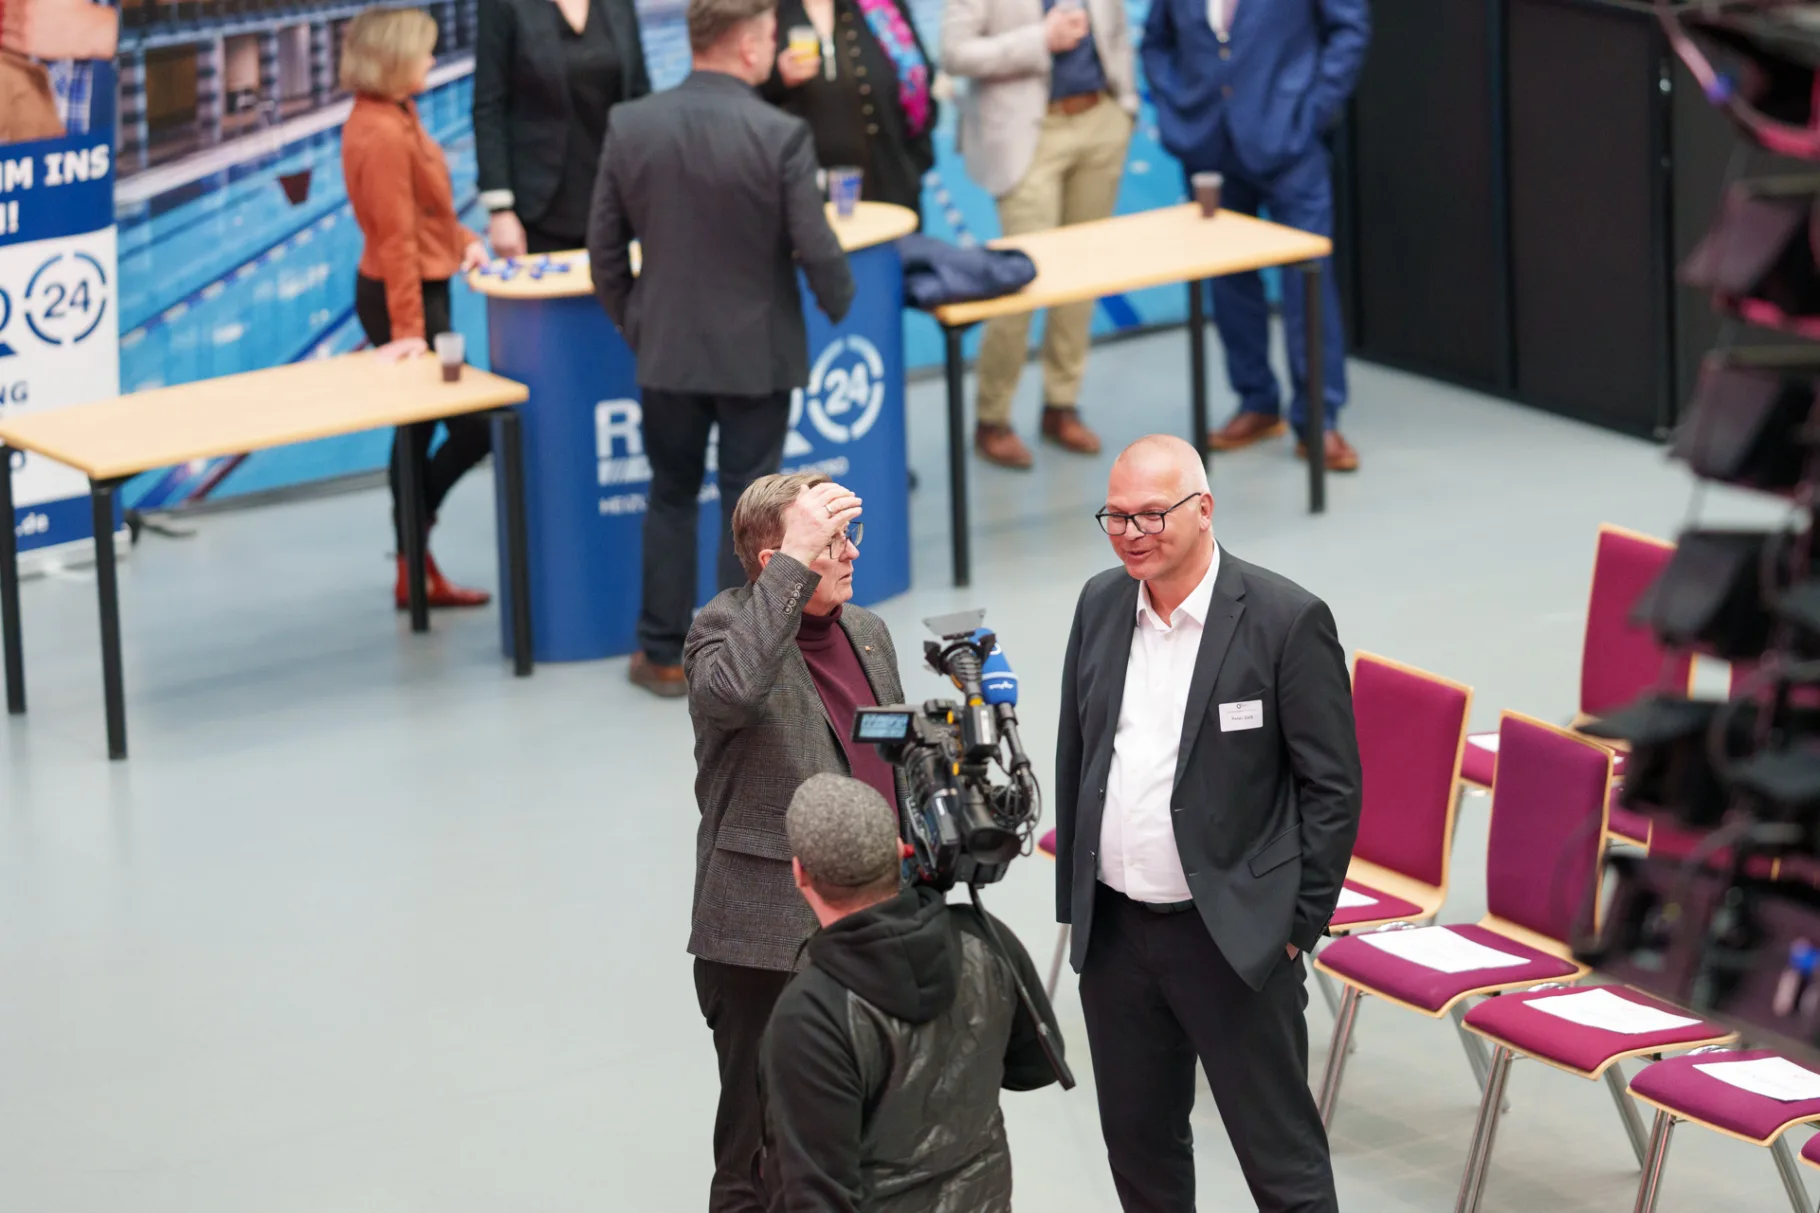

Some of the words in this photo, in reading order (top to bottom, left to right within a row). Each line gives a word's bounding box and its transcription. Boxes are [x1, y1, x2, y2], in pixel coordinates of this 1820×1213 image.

[44, 143, 110, 188] INS
[43, 278, 90, 319] 24
[824, 362, 870, 416] 24
